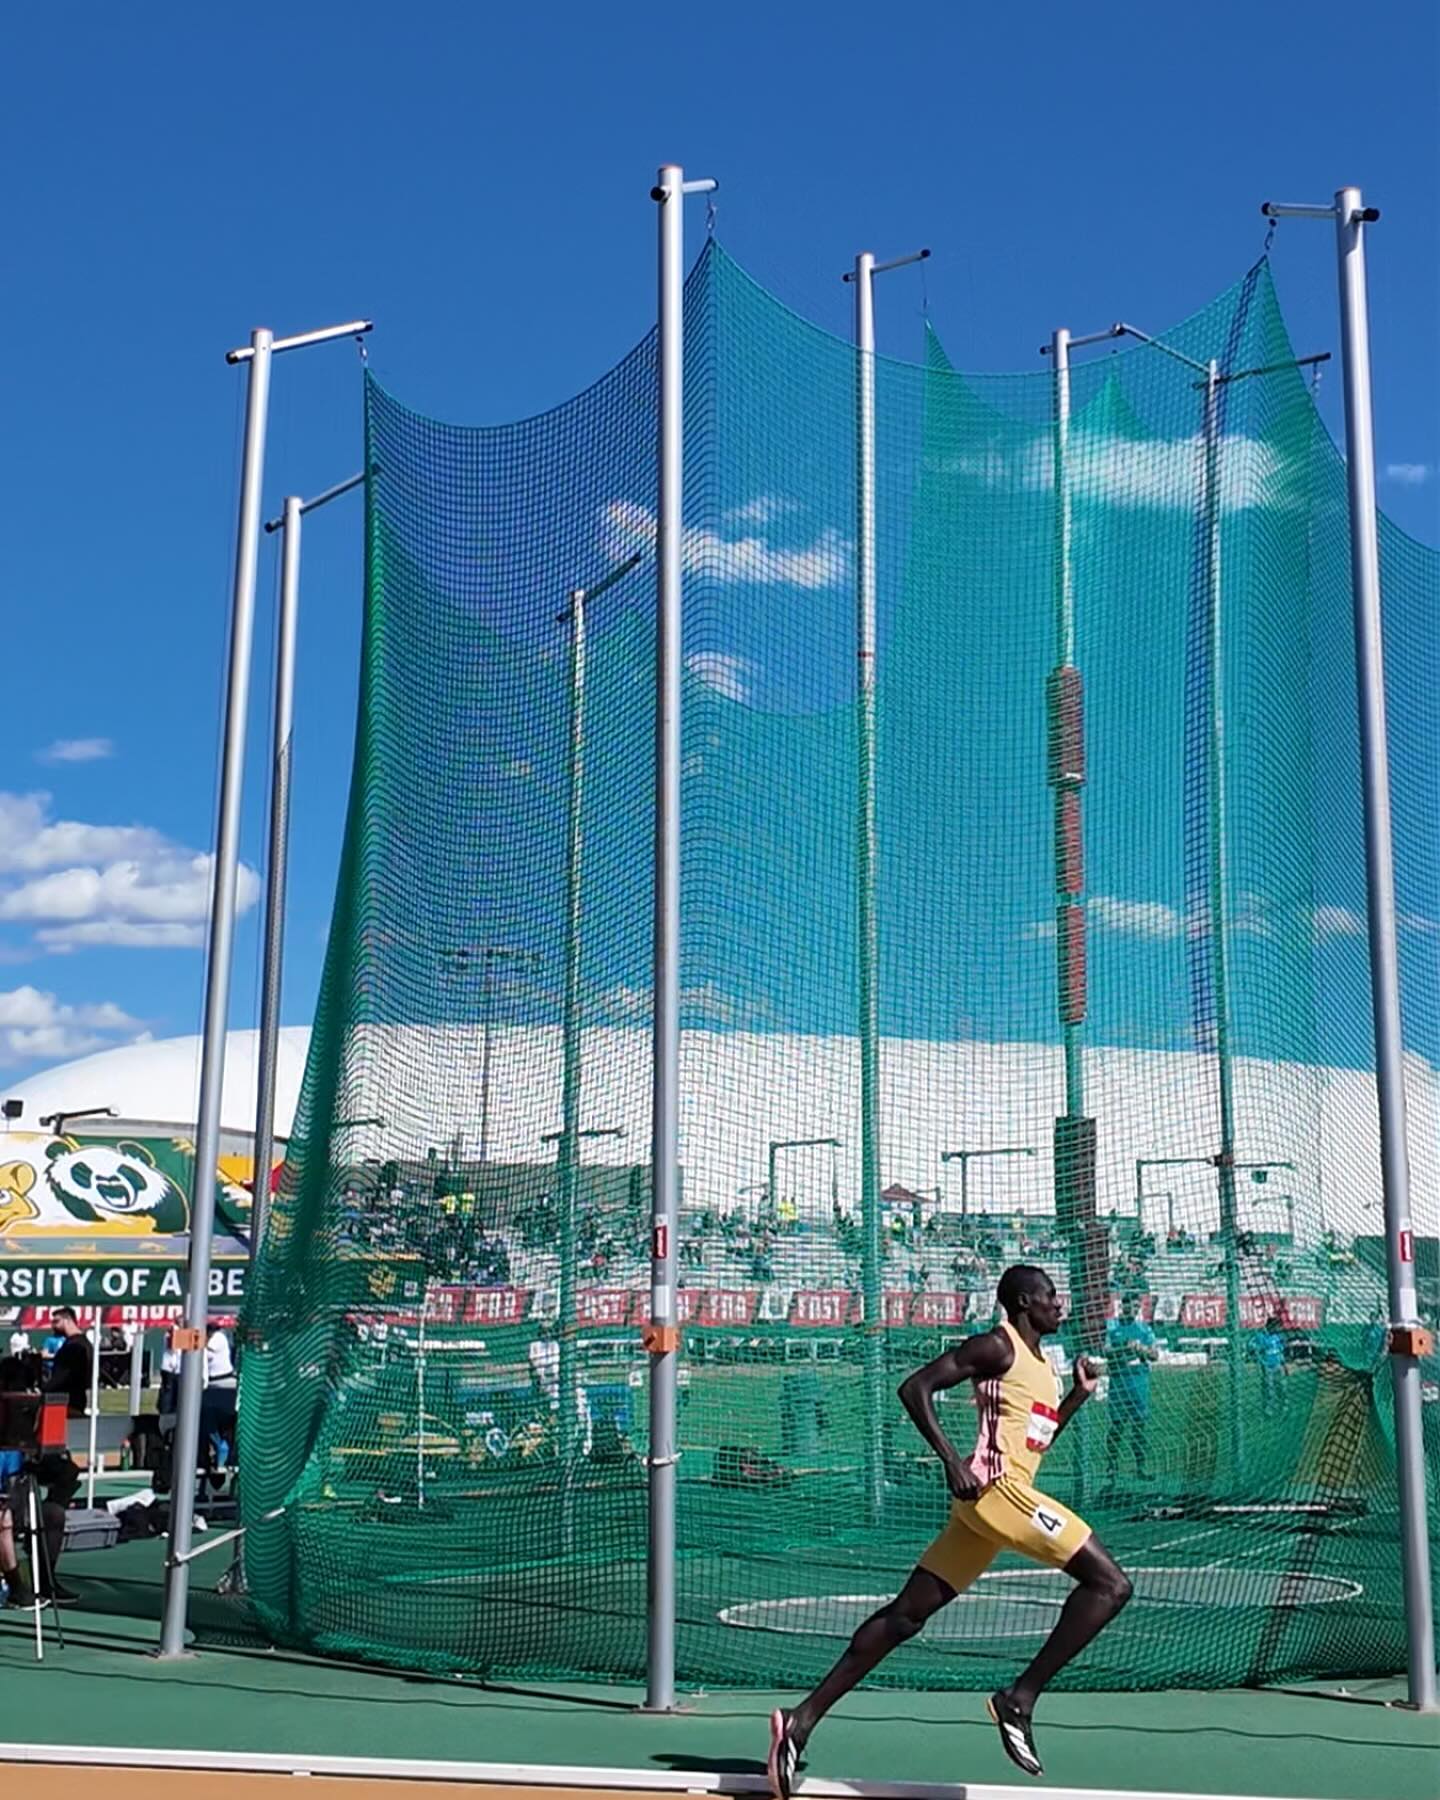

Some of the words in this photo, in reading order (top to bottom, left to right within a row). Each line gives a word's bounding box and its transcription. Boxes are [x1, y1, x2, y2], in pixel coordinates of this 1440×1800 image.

[102, 1267, 150, 1297] OF
[159, 1268, 245, 1297] ABE
[797, 1295, 840, 1320] FAST
[1185, 1299, 1222, 1322] FAST
[1037, 1511, 1062, 1531] 4
